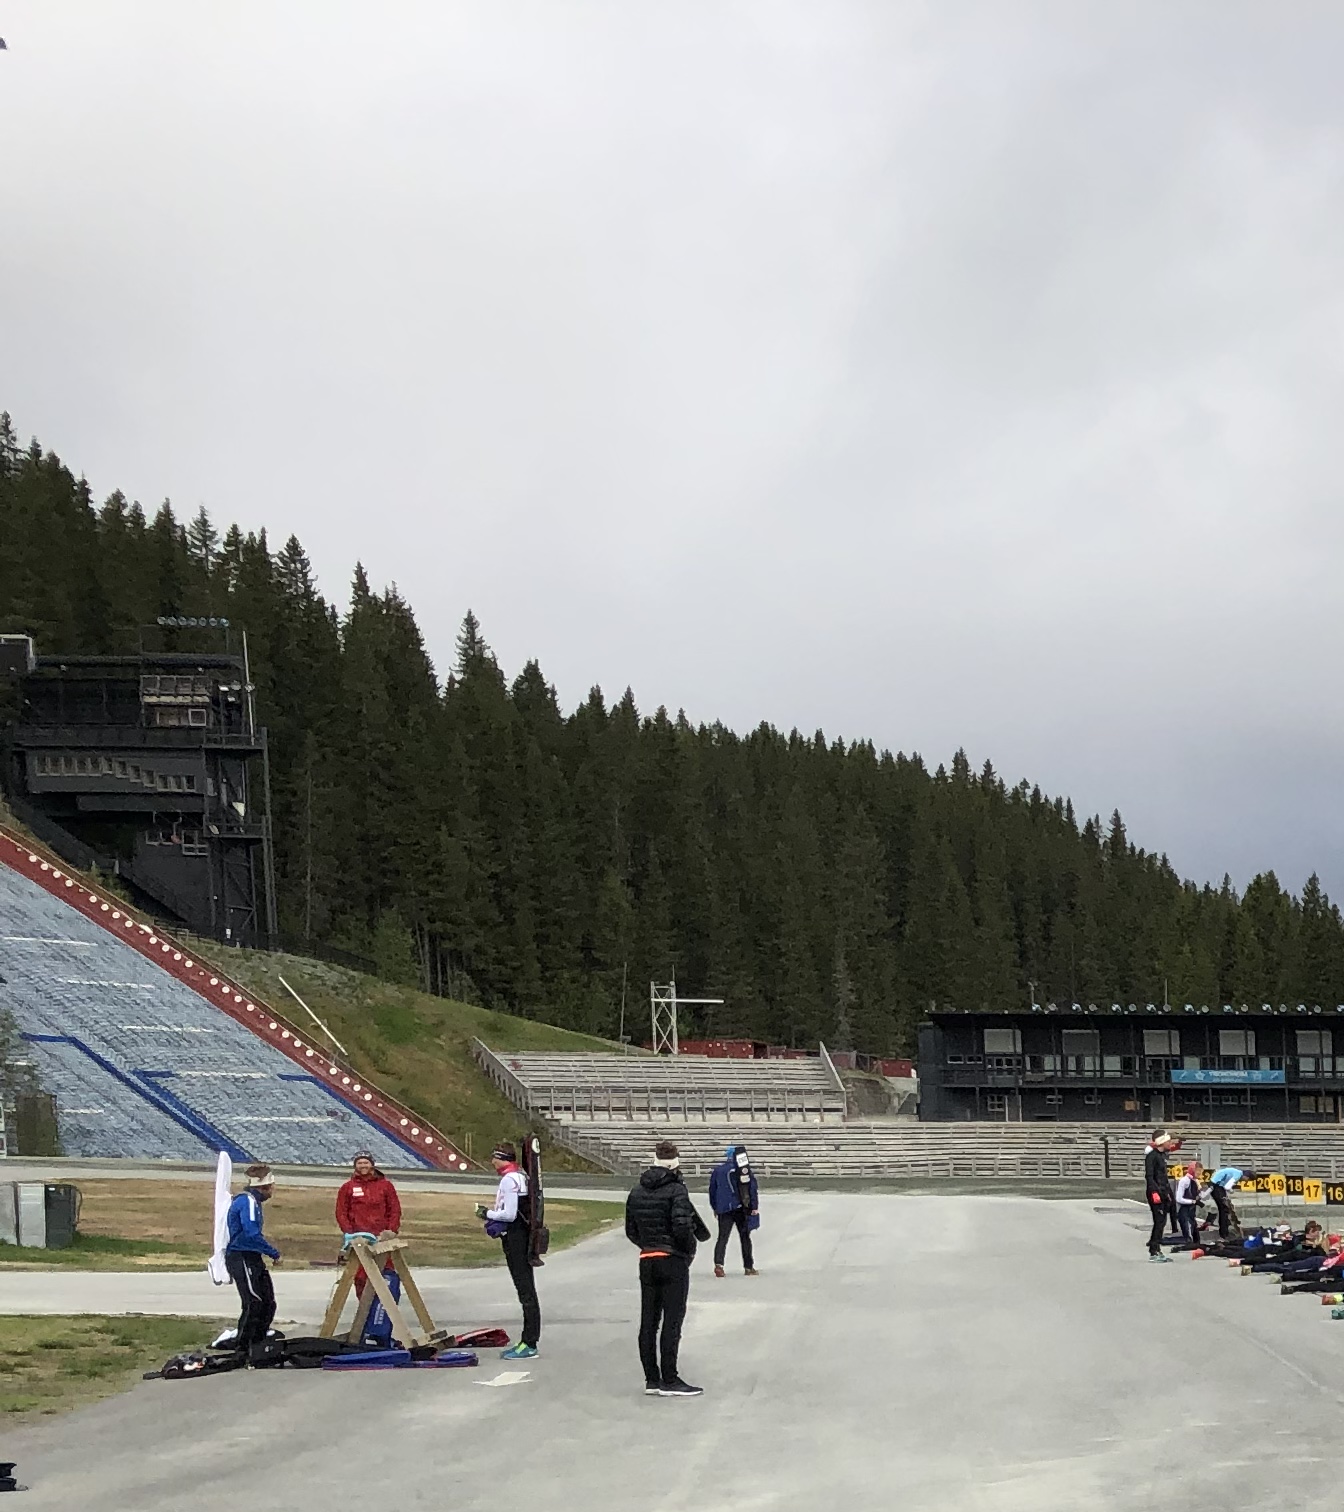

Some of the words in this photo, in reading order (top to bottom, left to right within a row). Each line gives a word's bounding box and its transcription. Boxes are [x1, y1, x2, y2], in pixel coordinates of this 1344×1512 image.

[1257, 1178, 1270, 1189] 20
[1271, 1179, 1285, 1191] 19
[1288, 1179, 1302, 1191] 18
[1306, 1185, 1320, 1198] 17
[1328, 1187, 1343, 1200] 16
